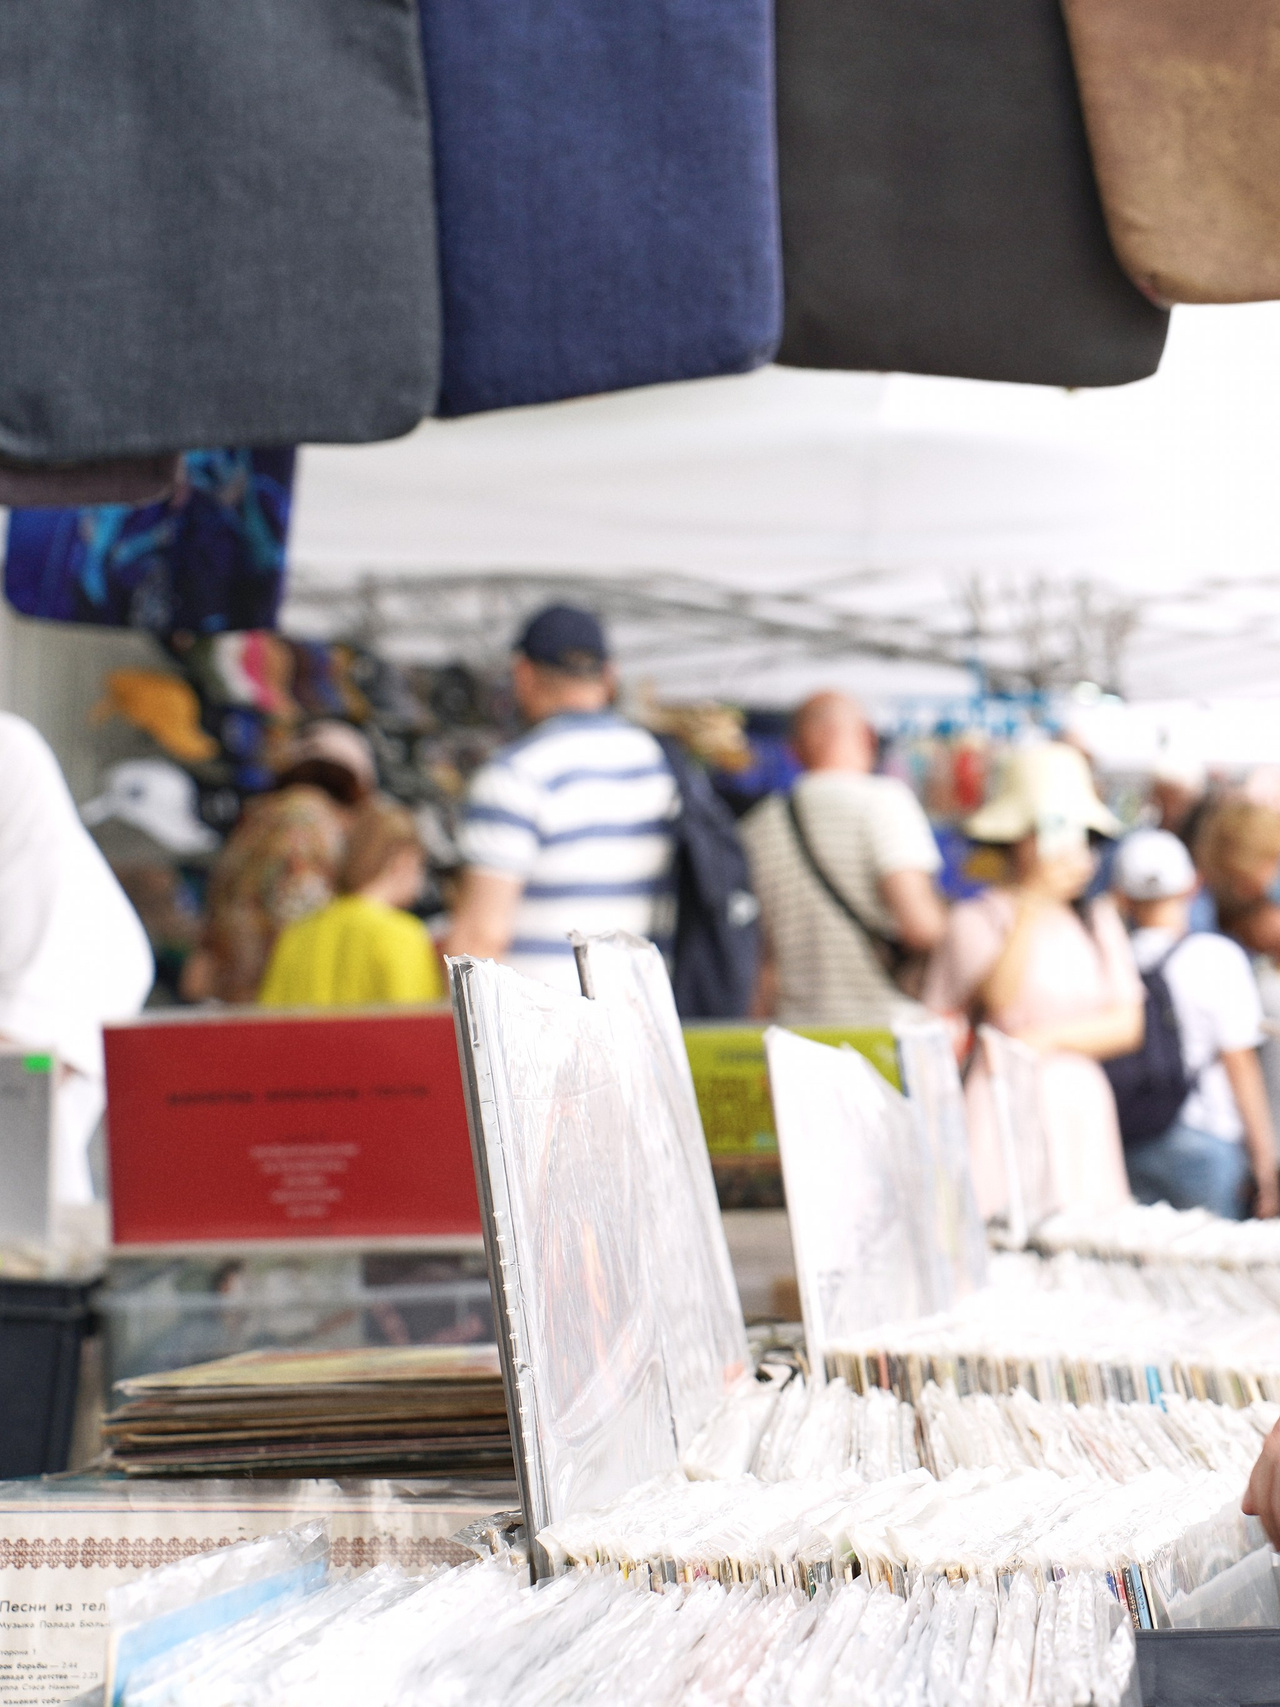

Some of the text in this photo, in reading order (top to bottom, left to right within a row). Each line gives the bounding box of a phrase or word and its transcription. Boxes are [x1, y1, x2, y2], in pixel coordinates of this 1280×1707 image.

[493, 1210, 534, 1463] SOUNDGARDEN
[0, 1600, 47, 1612] Песни
[55, 1602, 73, 1612] из
